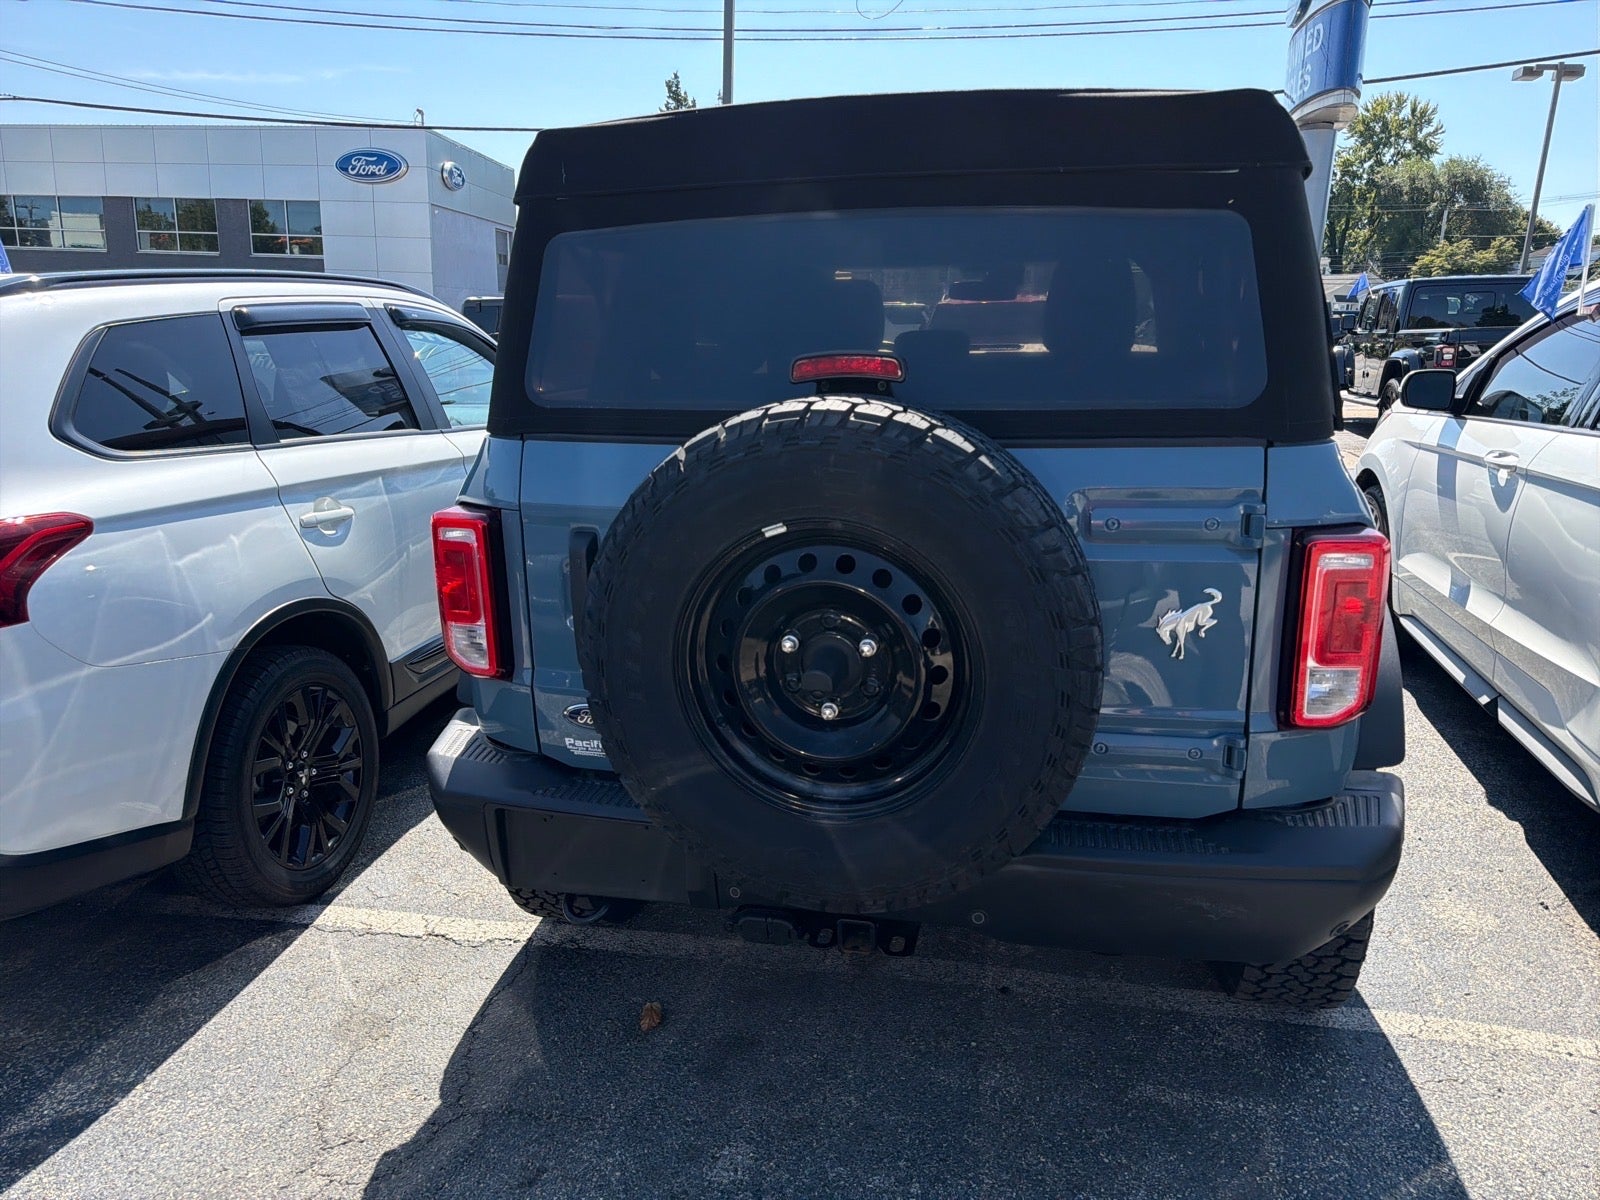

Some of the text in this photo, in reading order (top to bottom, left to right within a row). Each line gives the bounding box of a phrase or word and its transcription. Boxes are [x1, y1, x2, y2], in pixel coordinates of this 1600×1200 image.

[348, 155, 388, 175] Ford
[577, 709, 594, 724] Fo
[564, 737, 603, 749] Pacifi
